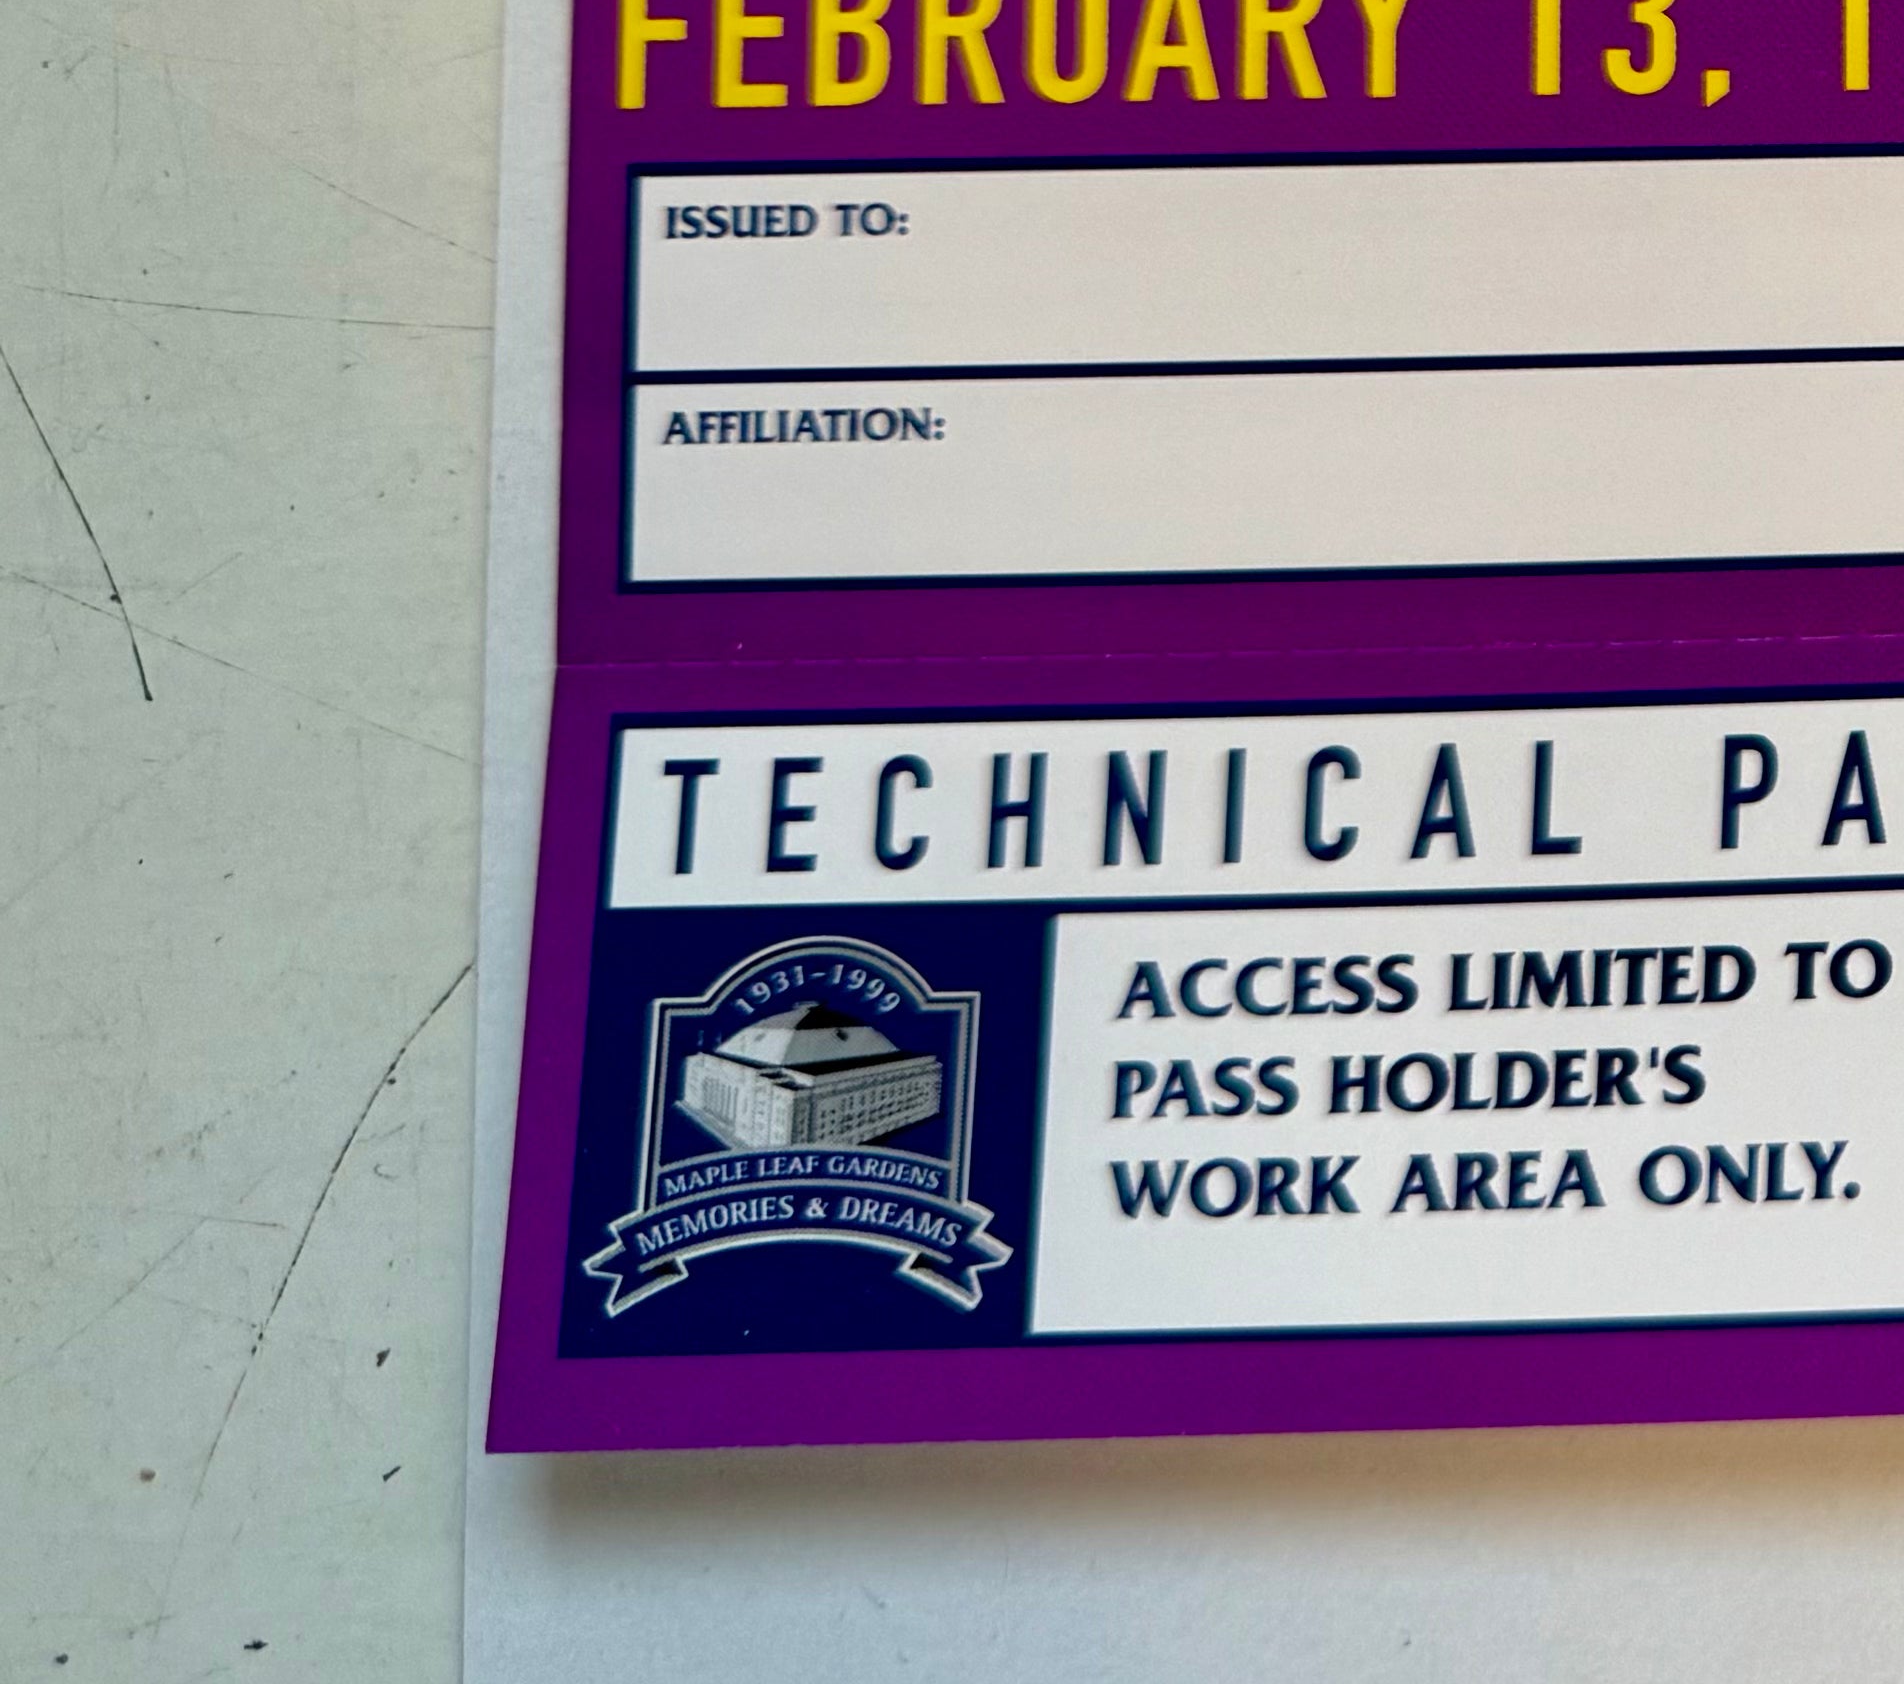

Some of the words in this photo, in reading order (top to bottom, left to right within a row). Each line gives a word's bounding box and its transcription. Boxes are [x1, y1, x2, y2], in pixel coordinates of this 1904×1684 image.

[664, 203, 819, 241] ISSUED
[833, 202, 910, 238] TO:
[663, 406, 947, 448] AFFILIATION:
[664, 738, 1584, 876] TECHNICAL
[736, 964, 901, 1014] 1931-1999
[1117, 952, 1418, 1024] ACCESS
[1443, 945, 1758, 1015] LIMITED
[1782, 938, 1893, 1002] TO
[1111, 1054, 1300, 1119] PASS
[1327, 1043, 1708, 1116] HOLDER'S
[665, 1159, 751, 1193] MAPLE
[758, 1154, 819, 1177] LEAF
[827, 1155, 941, 1191] GARDENS
[1111, 1151, 1362, 1220] WORK
[1387, 1147, 1606, 1215] AREA
[1636, 1139, 1862, 1209] ONLY.
[637, 1194, 794, 1256] MEMORIES
[806, 1196, 829, 1218] &
[839, 1196, 962, 1247] DREAMS
